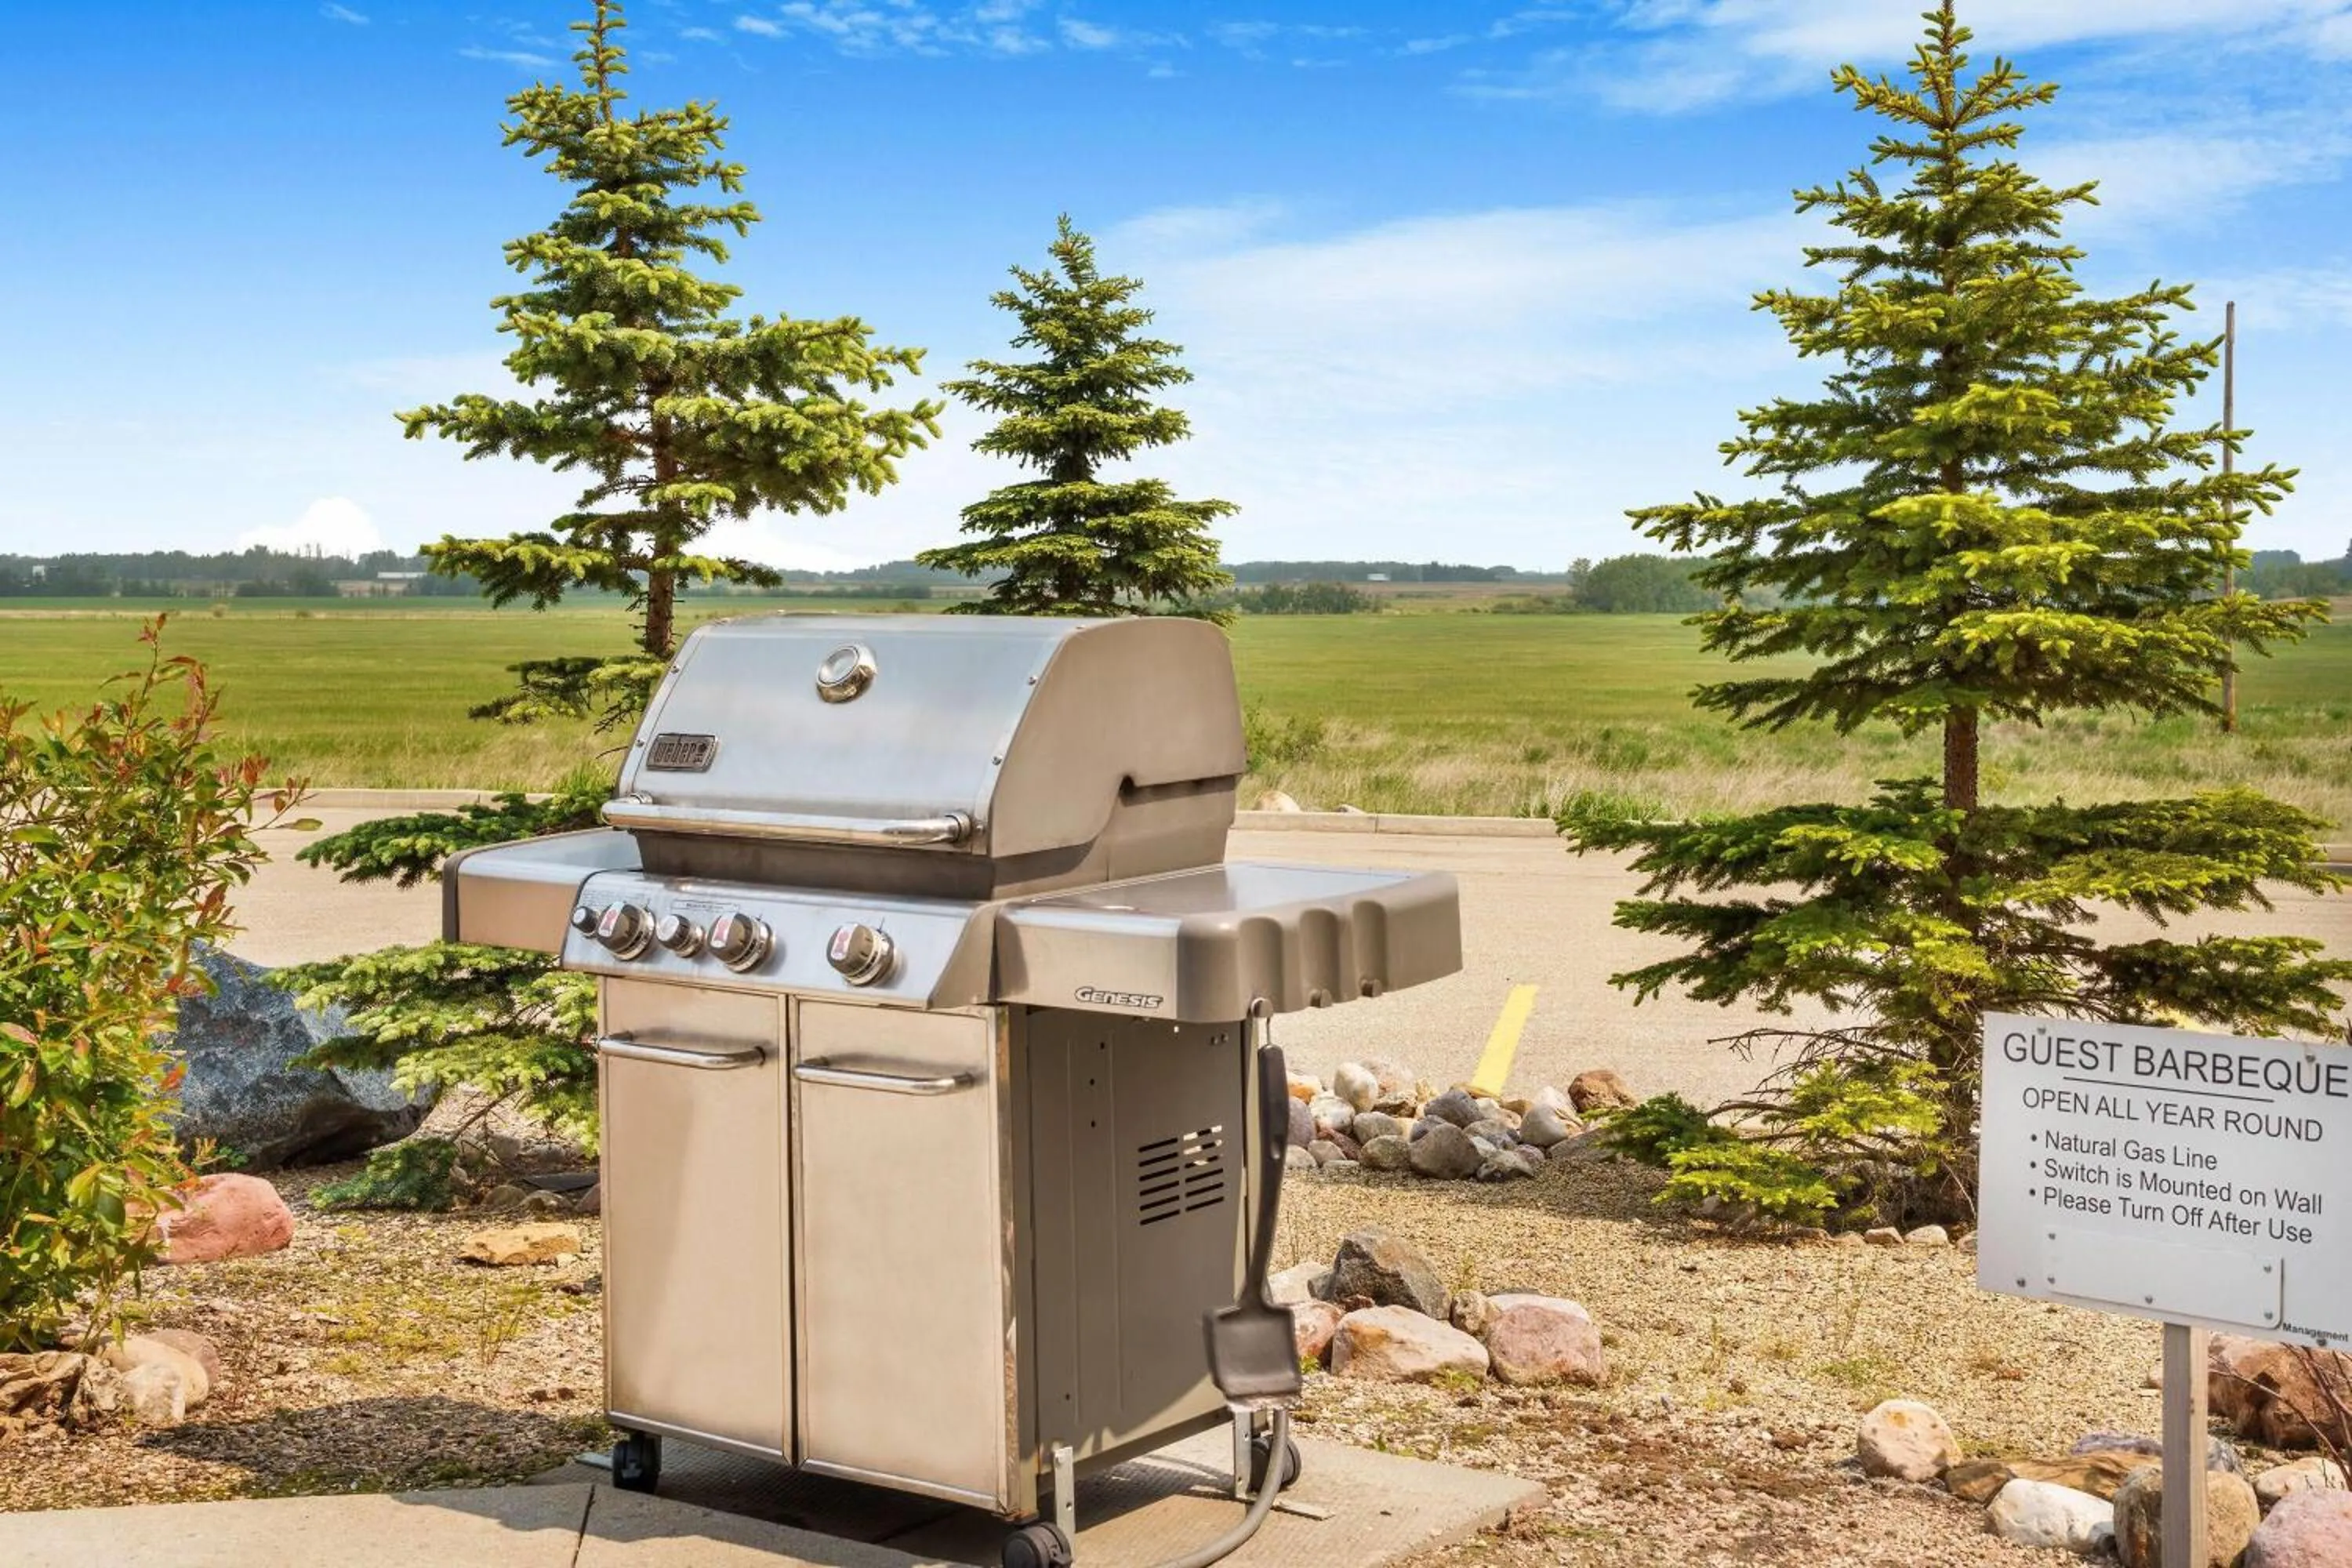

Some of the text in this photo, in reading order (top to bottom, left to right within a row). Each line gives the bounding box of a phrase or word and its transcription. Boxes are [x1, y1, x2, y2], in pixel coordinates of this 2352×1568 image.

[2003, 1032, 2349, 1098] GUEST BARBEQUE
[2022, 1087, 2323, 1142] OPEN ALL YEAR ROUND
[2045, 1129, 2218, 1171] Natural Gas Line
[2044, 1157, 2322, 1215] Switch is Mounted on Wall
[2043, 1185, 2313, 1244] Please Turn Off After Use
[2282, 1323, 2349, 1342] Management
